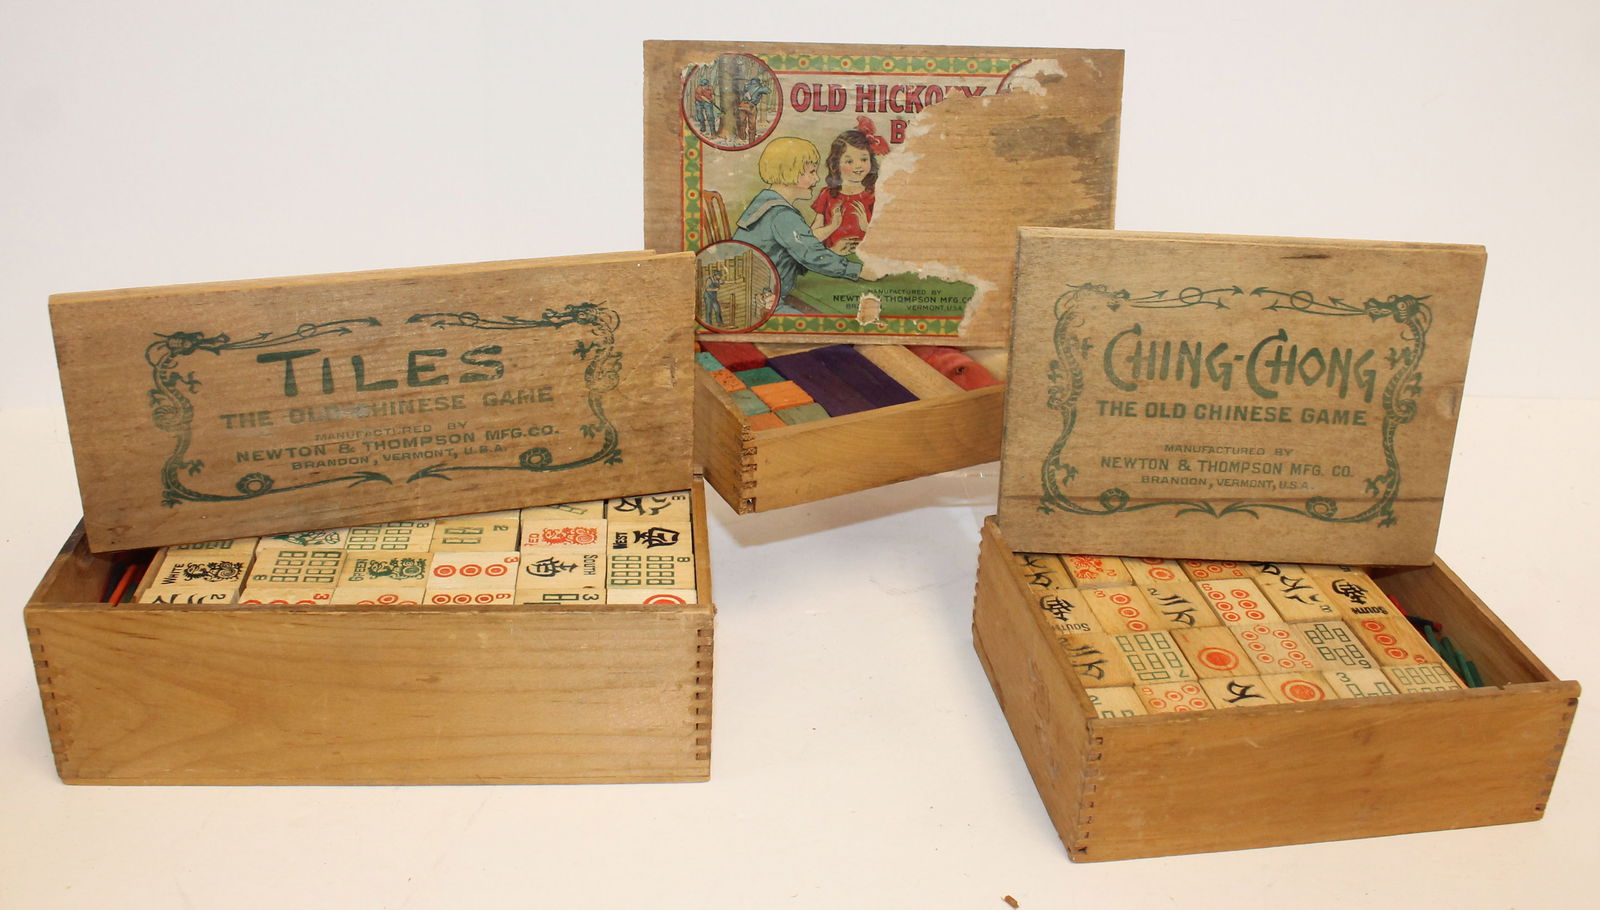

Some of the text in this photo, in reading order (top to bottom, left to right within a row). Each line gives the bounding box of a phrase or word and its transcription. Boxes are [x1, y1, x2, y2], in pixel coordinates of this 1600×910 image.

[790, 83, 987, 113] OLD HICKOY
[884, 296, 937, 304] THOMPSON
[256, 345, 505, 397] TILES
[1103, 323, 1377, 403] CHING-CHONG
[219, 410, 274, 430] THE
[482, 386, 554, 408] GAME
[1096, 400, 1368, 426] THE OLD CHINESE GAME
[315, 421, 468, 441] MANUFACTURED BY
[236, 445, 327, 464] NEWTON
[338, 442, 356, 454] &
[362, 432, 475, 452] THOMPSON
[382, 447, 460, 462] VERMONT,
[1164, 444, 1294, 457] MANUFACTURED BY
[1100, 456, 1354, 478] NEWTON & THOMPSON MFG. CO.
[1141, 475, 1213, 490] BRANDON,
[1217, 478, 1277, 492] VERMONT,
[613, 532, 628, 549] WEST
[504, 556, 520, 564] 3
[583, 554, 599, 576] SOUTH
[161, 563, 185, 585] WHITE
[583, 593, 600, 601] 3
[1351, 606, 1389, 616] SOUTH
[1336, 672, 1352, 683] 3
